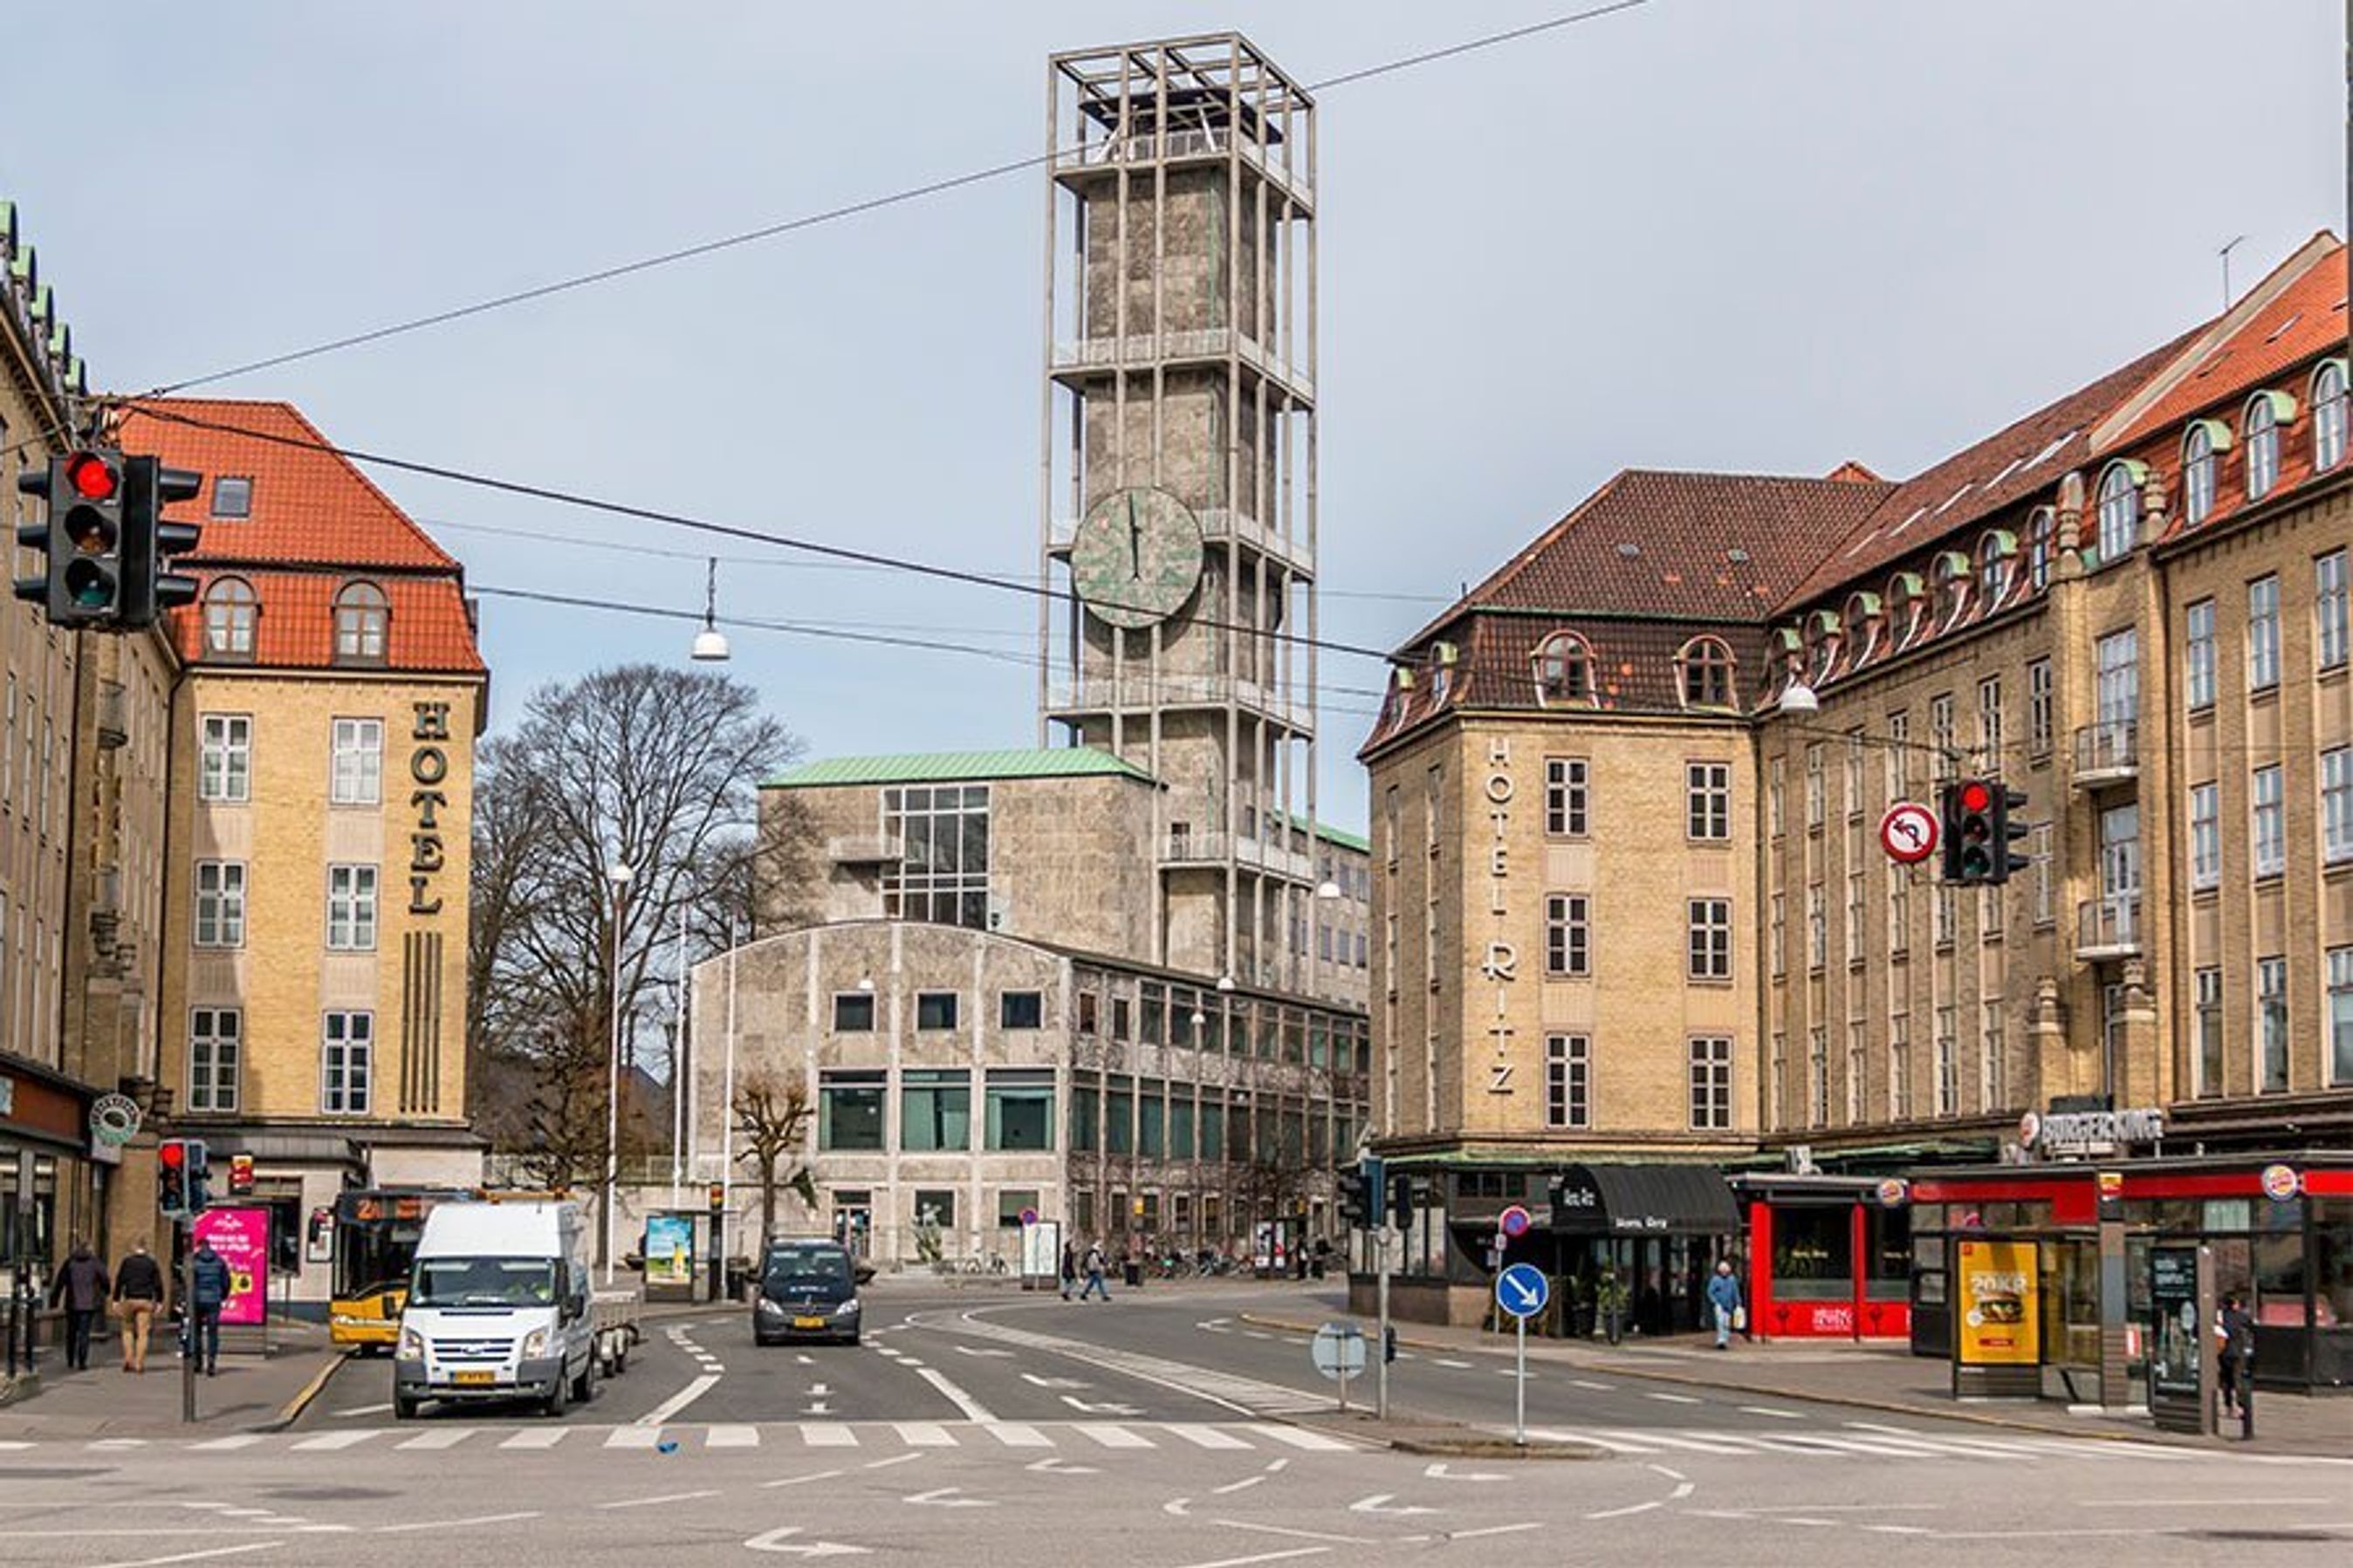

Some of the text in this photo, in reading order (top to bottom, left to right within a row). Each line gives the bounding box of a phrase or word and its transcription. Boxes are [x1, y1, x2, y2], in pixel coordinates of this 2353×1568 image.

[408, 702, 451, 915] HOTEL
[1482, 737, 1517, 1095] HOTEL RITZ
[2042, 1113, 2114, 1145] BURGER
[2114, 1107, 2165, 1140] KING
